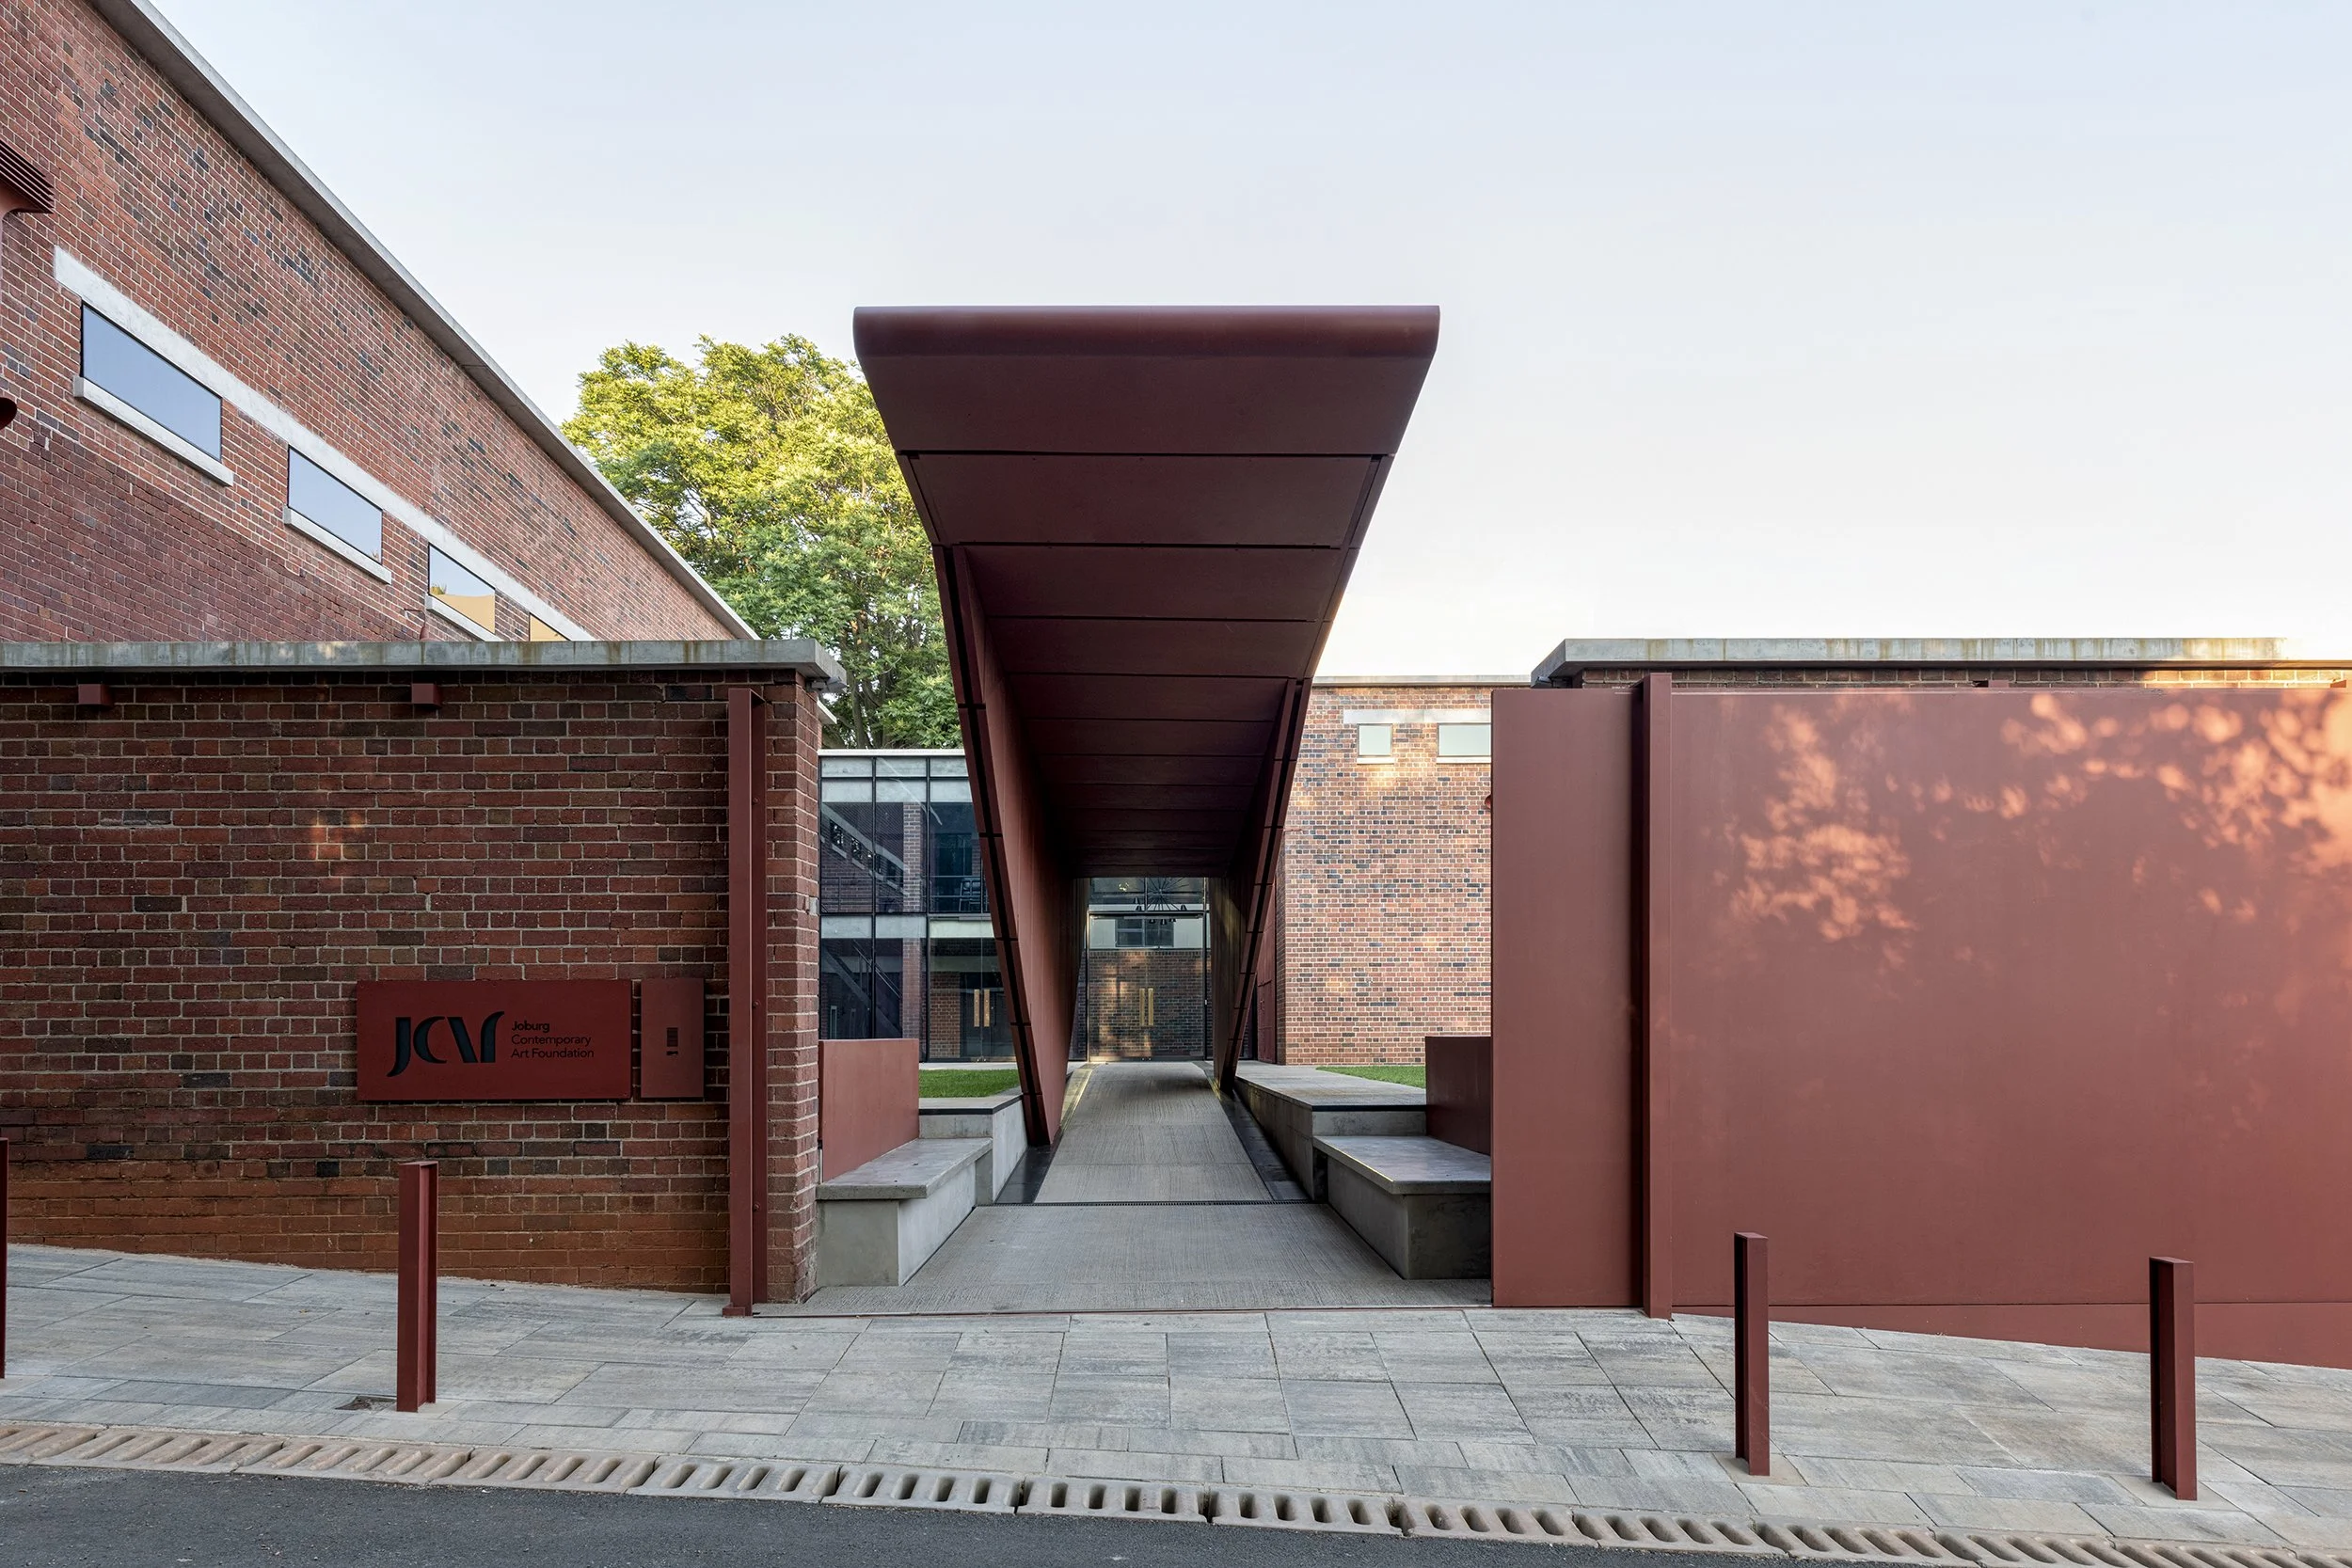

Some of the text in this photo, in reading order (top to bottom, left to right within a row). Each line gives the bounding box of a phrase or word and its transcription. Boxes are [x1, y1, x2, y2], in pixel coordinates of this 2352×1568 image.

[511, 1021, 550, 1032] Joburg
[511, 1034, 592, 1046] Contemporary
[511, 1048, 595, 1058] Art Foundation
